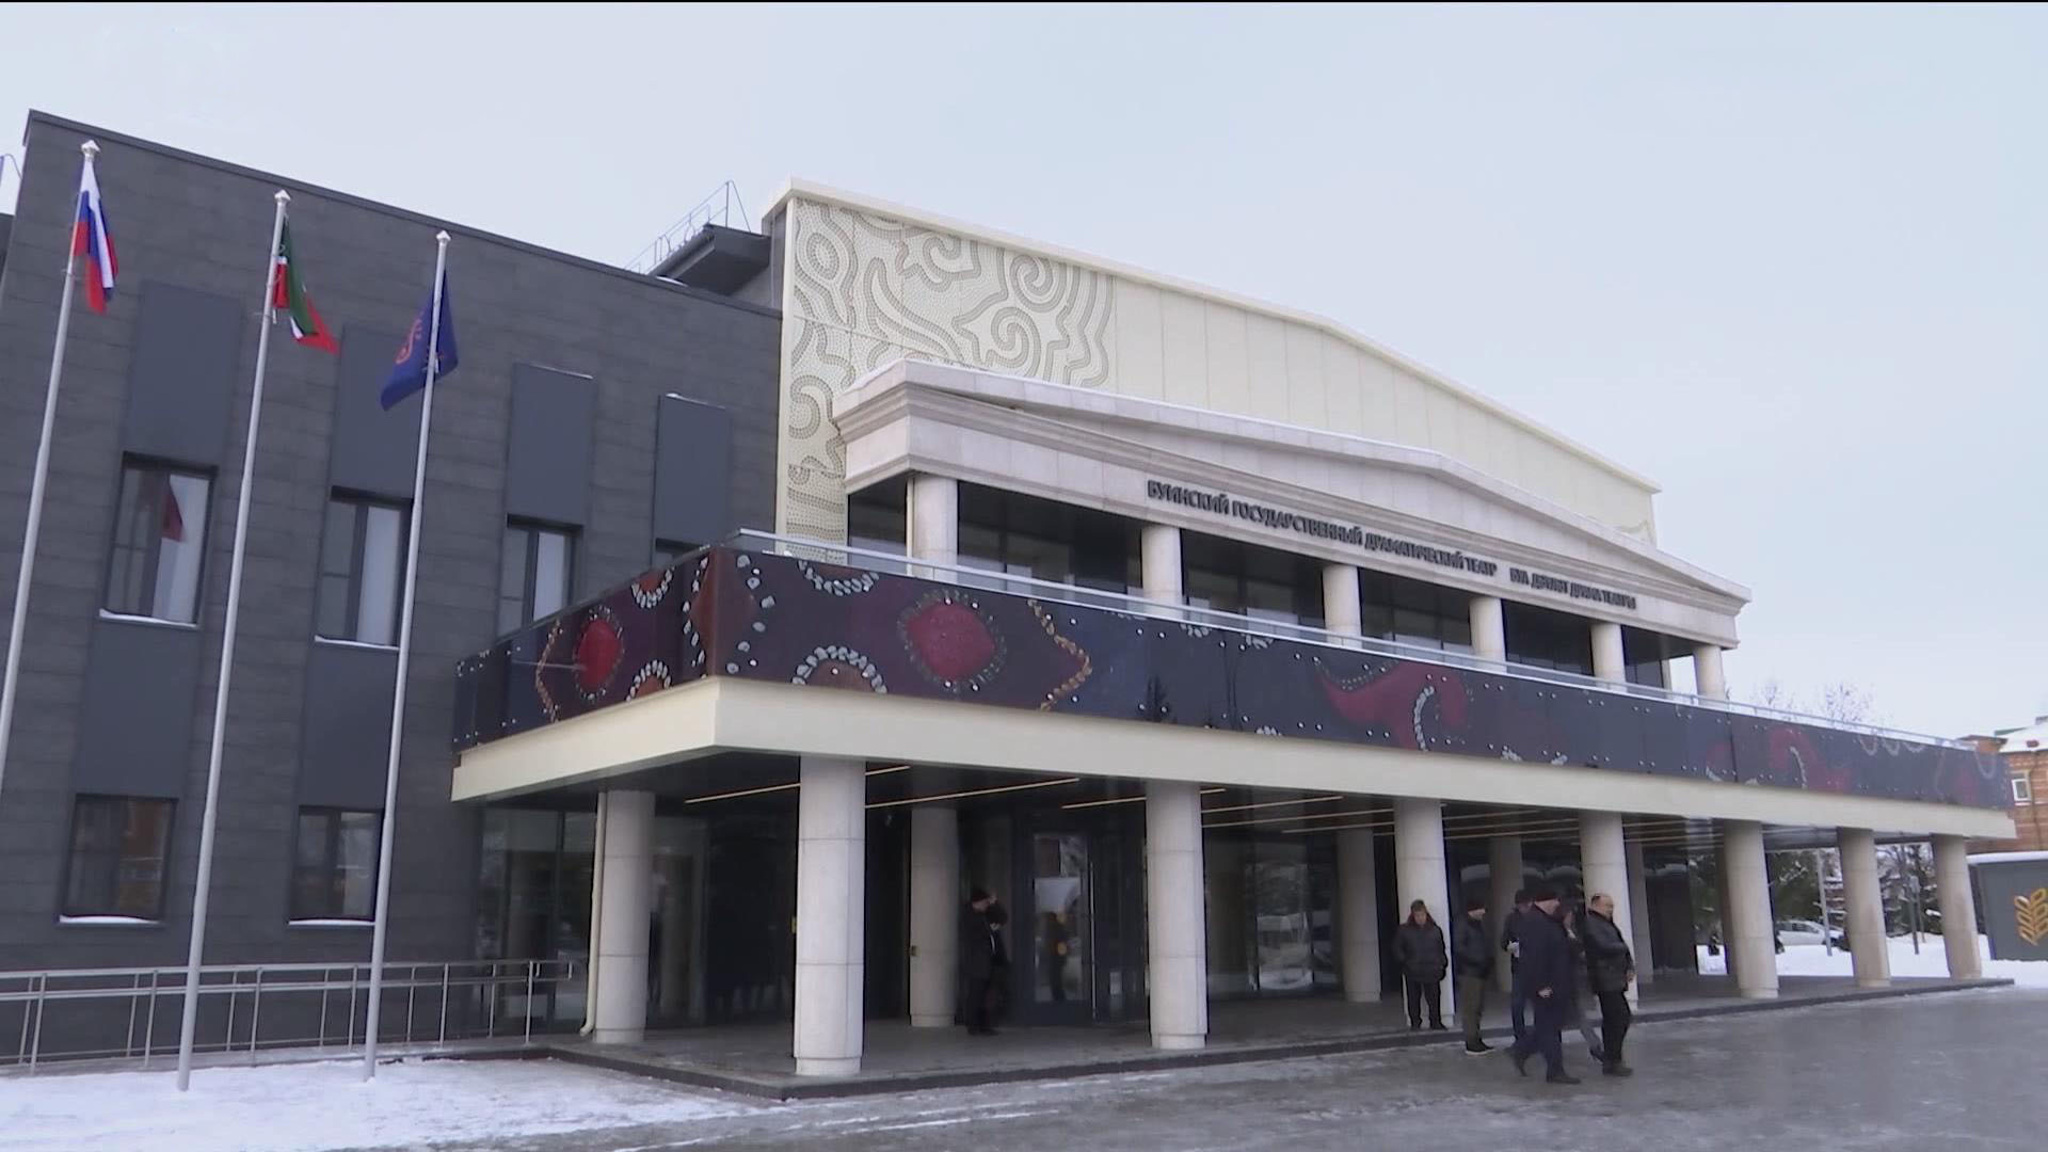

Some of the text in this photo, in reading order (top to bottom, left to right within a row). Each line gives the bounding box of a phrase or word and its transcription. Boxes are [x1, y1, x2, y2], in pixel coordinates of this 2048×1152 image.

[1147, 479, 1497, 577] БУИНСКИЙ ГОСУДАРСТВЕННЫЙ ДРАМАТИЧЕСКИЙ ТЕАТР
